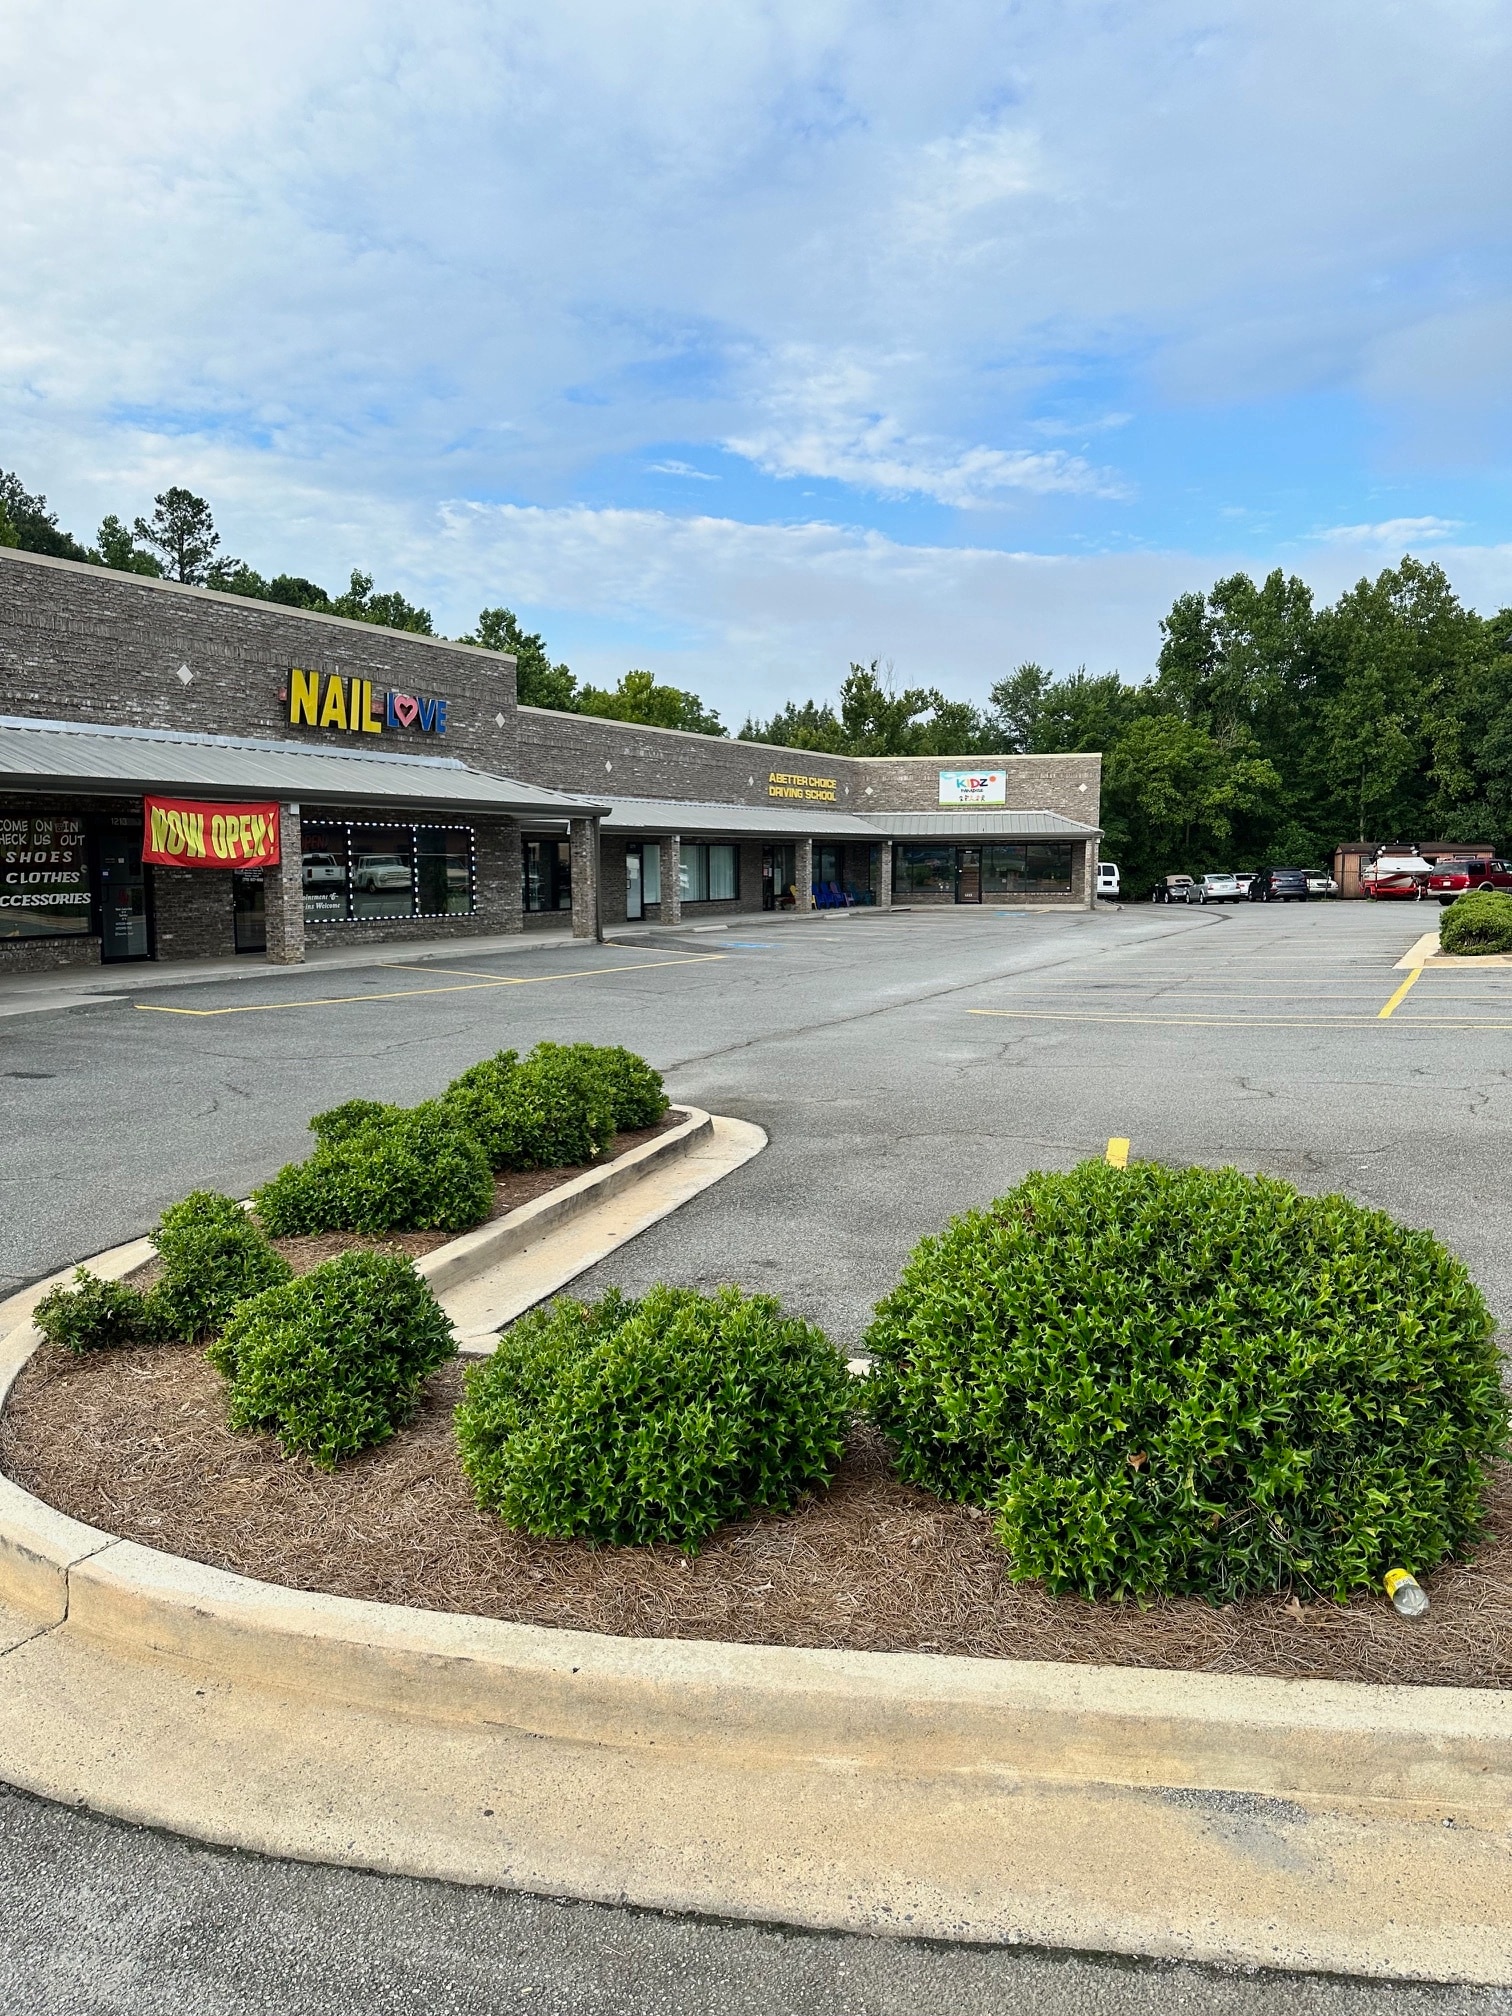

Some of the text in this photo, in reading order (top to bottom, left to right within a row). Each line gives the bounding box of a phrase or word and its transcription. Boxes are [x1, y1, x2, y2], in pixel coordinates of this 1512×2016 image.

[289, 668, 382, 734] NAIL
[769, 772, 837, 789] A BETTER CHOICE
[956, 778, 989, 789] KIDZ
[769, 786, 837, 802] DRIVING SCHOOL
[35, 820, 53, 832] ON
[62, 820, 79, 833] IN
[151, 805, 275, 859] NOW OPEN!
[34, 833, 52, 846] US
[60, 834, 86, 847] OUT
[302, 834, 328, 850] PEN
[5, 851, 73, 863] SHOES
[5, 871, 81, 884] CLOTHES
[315, 902, 341, 910] Welcome
